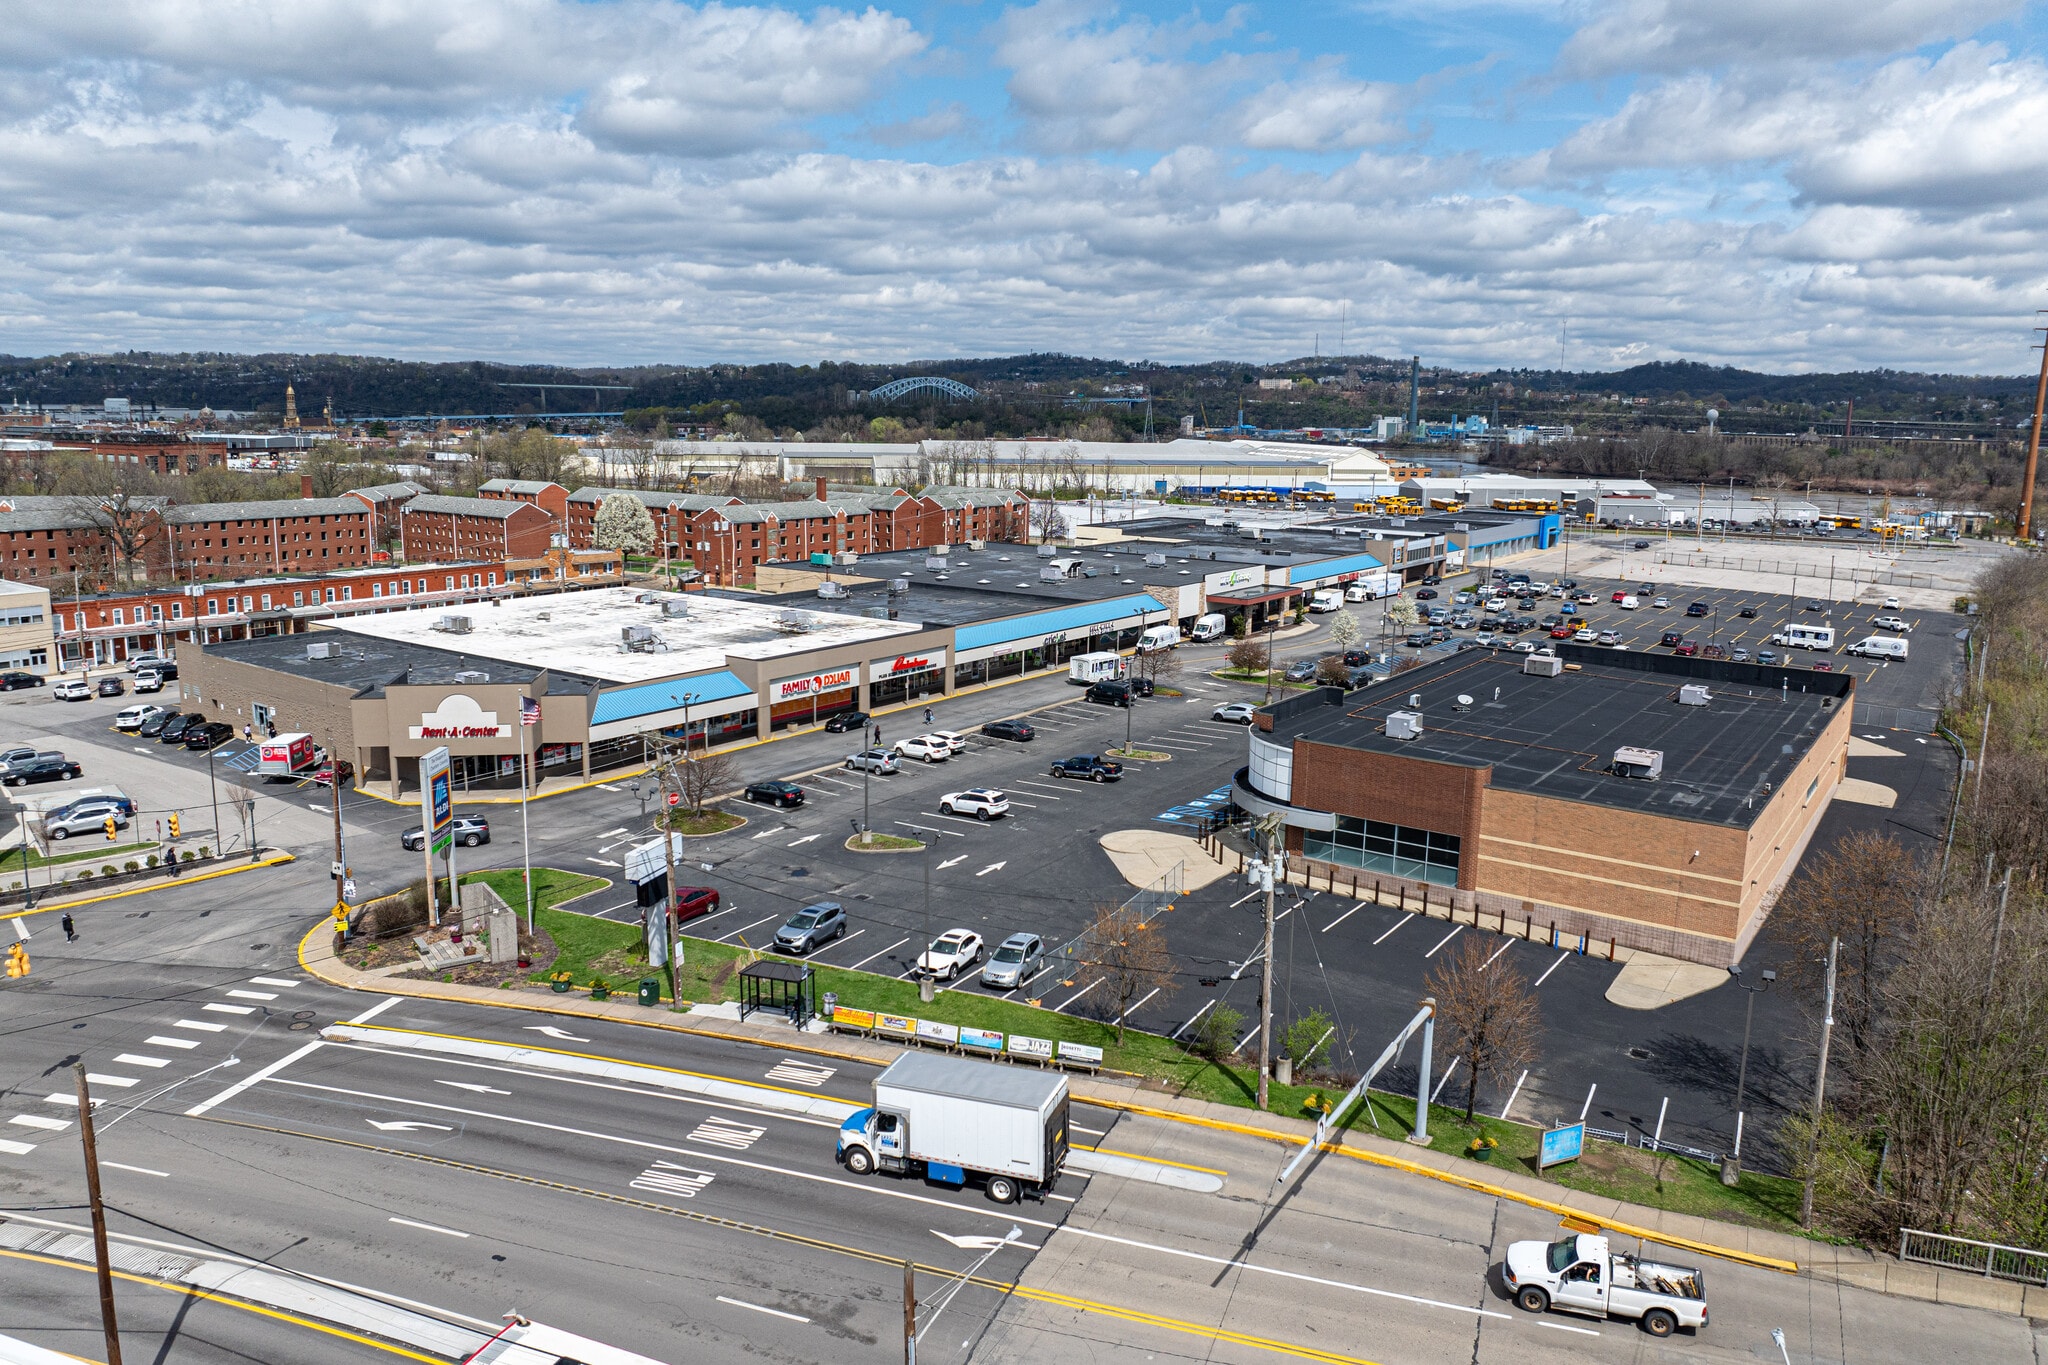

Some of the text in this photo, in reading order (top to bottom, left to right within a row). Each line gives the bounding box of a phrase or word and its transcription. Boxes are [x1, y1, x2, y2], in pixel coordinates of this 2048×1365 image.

[782, 671, 851, 695] FAMILY DOLLAR
[435, 800, 449, 818] ALDI
[1029, 1040, 1051, 1053] JAZZ
[764, 1058, 838, 1087] ONLY
[686, 1115, 768, 1150] ONLY
[629, 1159, 717, 1198] ONLY
